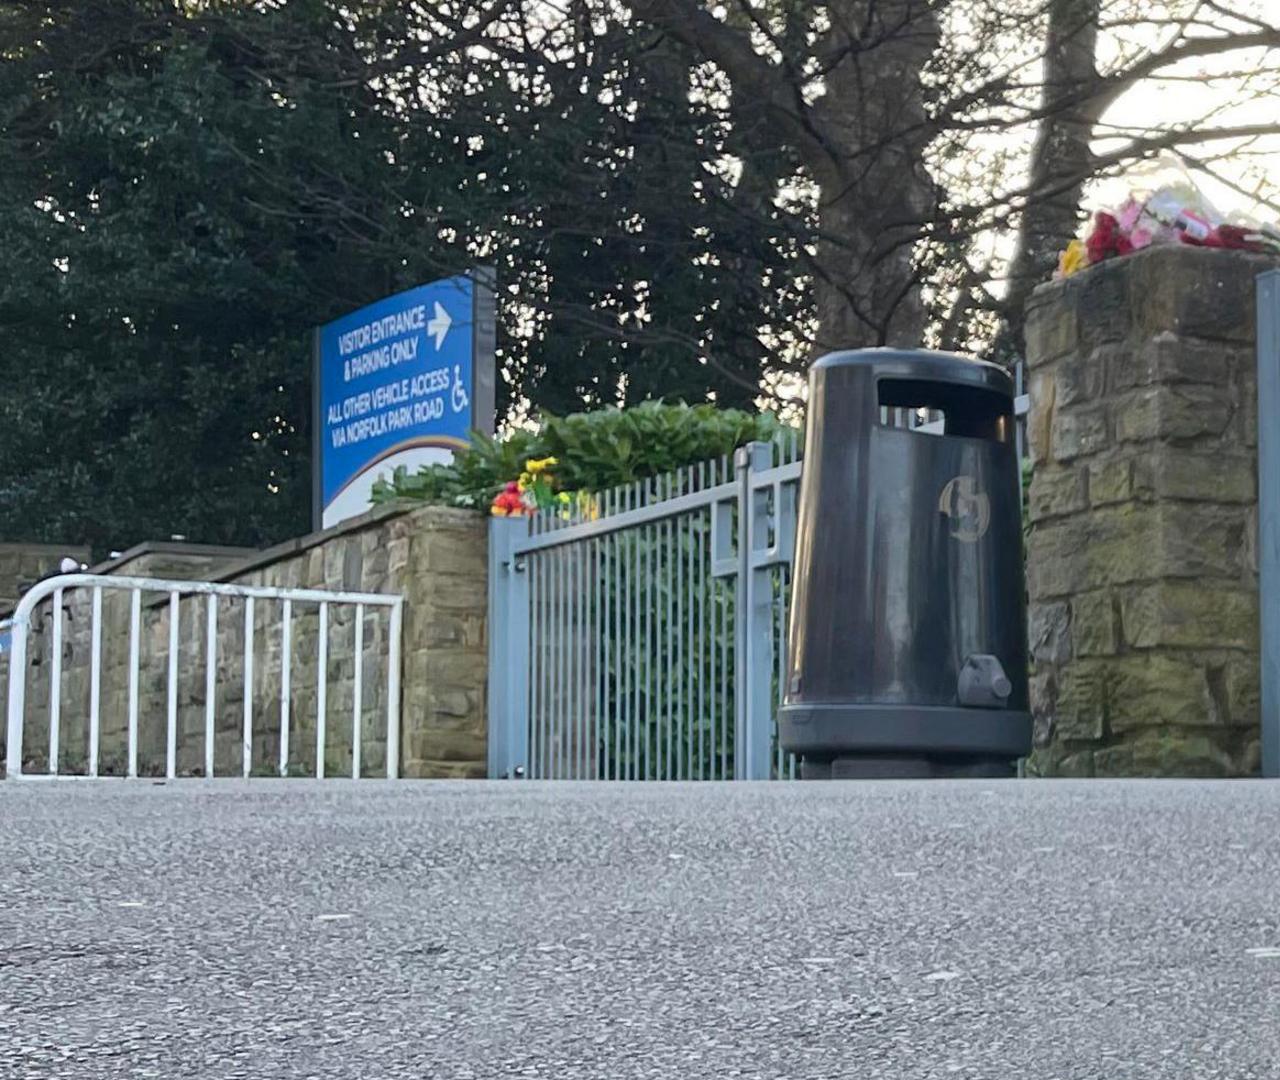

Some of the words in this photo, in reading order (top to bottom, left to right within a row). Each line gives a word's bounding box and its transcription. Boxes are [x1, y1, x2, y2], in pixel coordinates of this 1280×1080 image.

[339, 326, 371, 355] VISITOR
[372, 306, 425, 343] ENTRANCE
[344, 361, 351, 381] &
[351, 347, 390, 378] PARKING
[391, 336, 419, 365] ONLY
[328, 405, 343, 424] ALL
[343, 393, 371, 419] OTHER
[371, 380, 409, 409] VEHICLE
[411, 368, 450, 398] ACCESS
[332, 427, 347, 448] VIA
[346, 414, 388, 443] NORFOLK
[388, 405, 414, 431] PARK
[414, 398, 444, 423] ROAD
